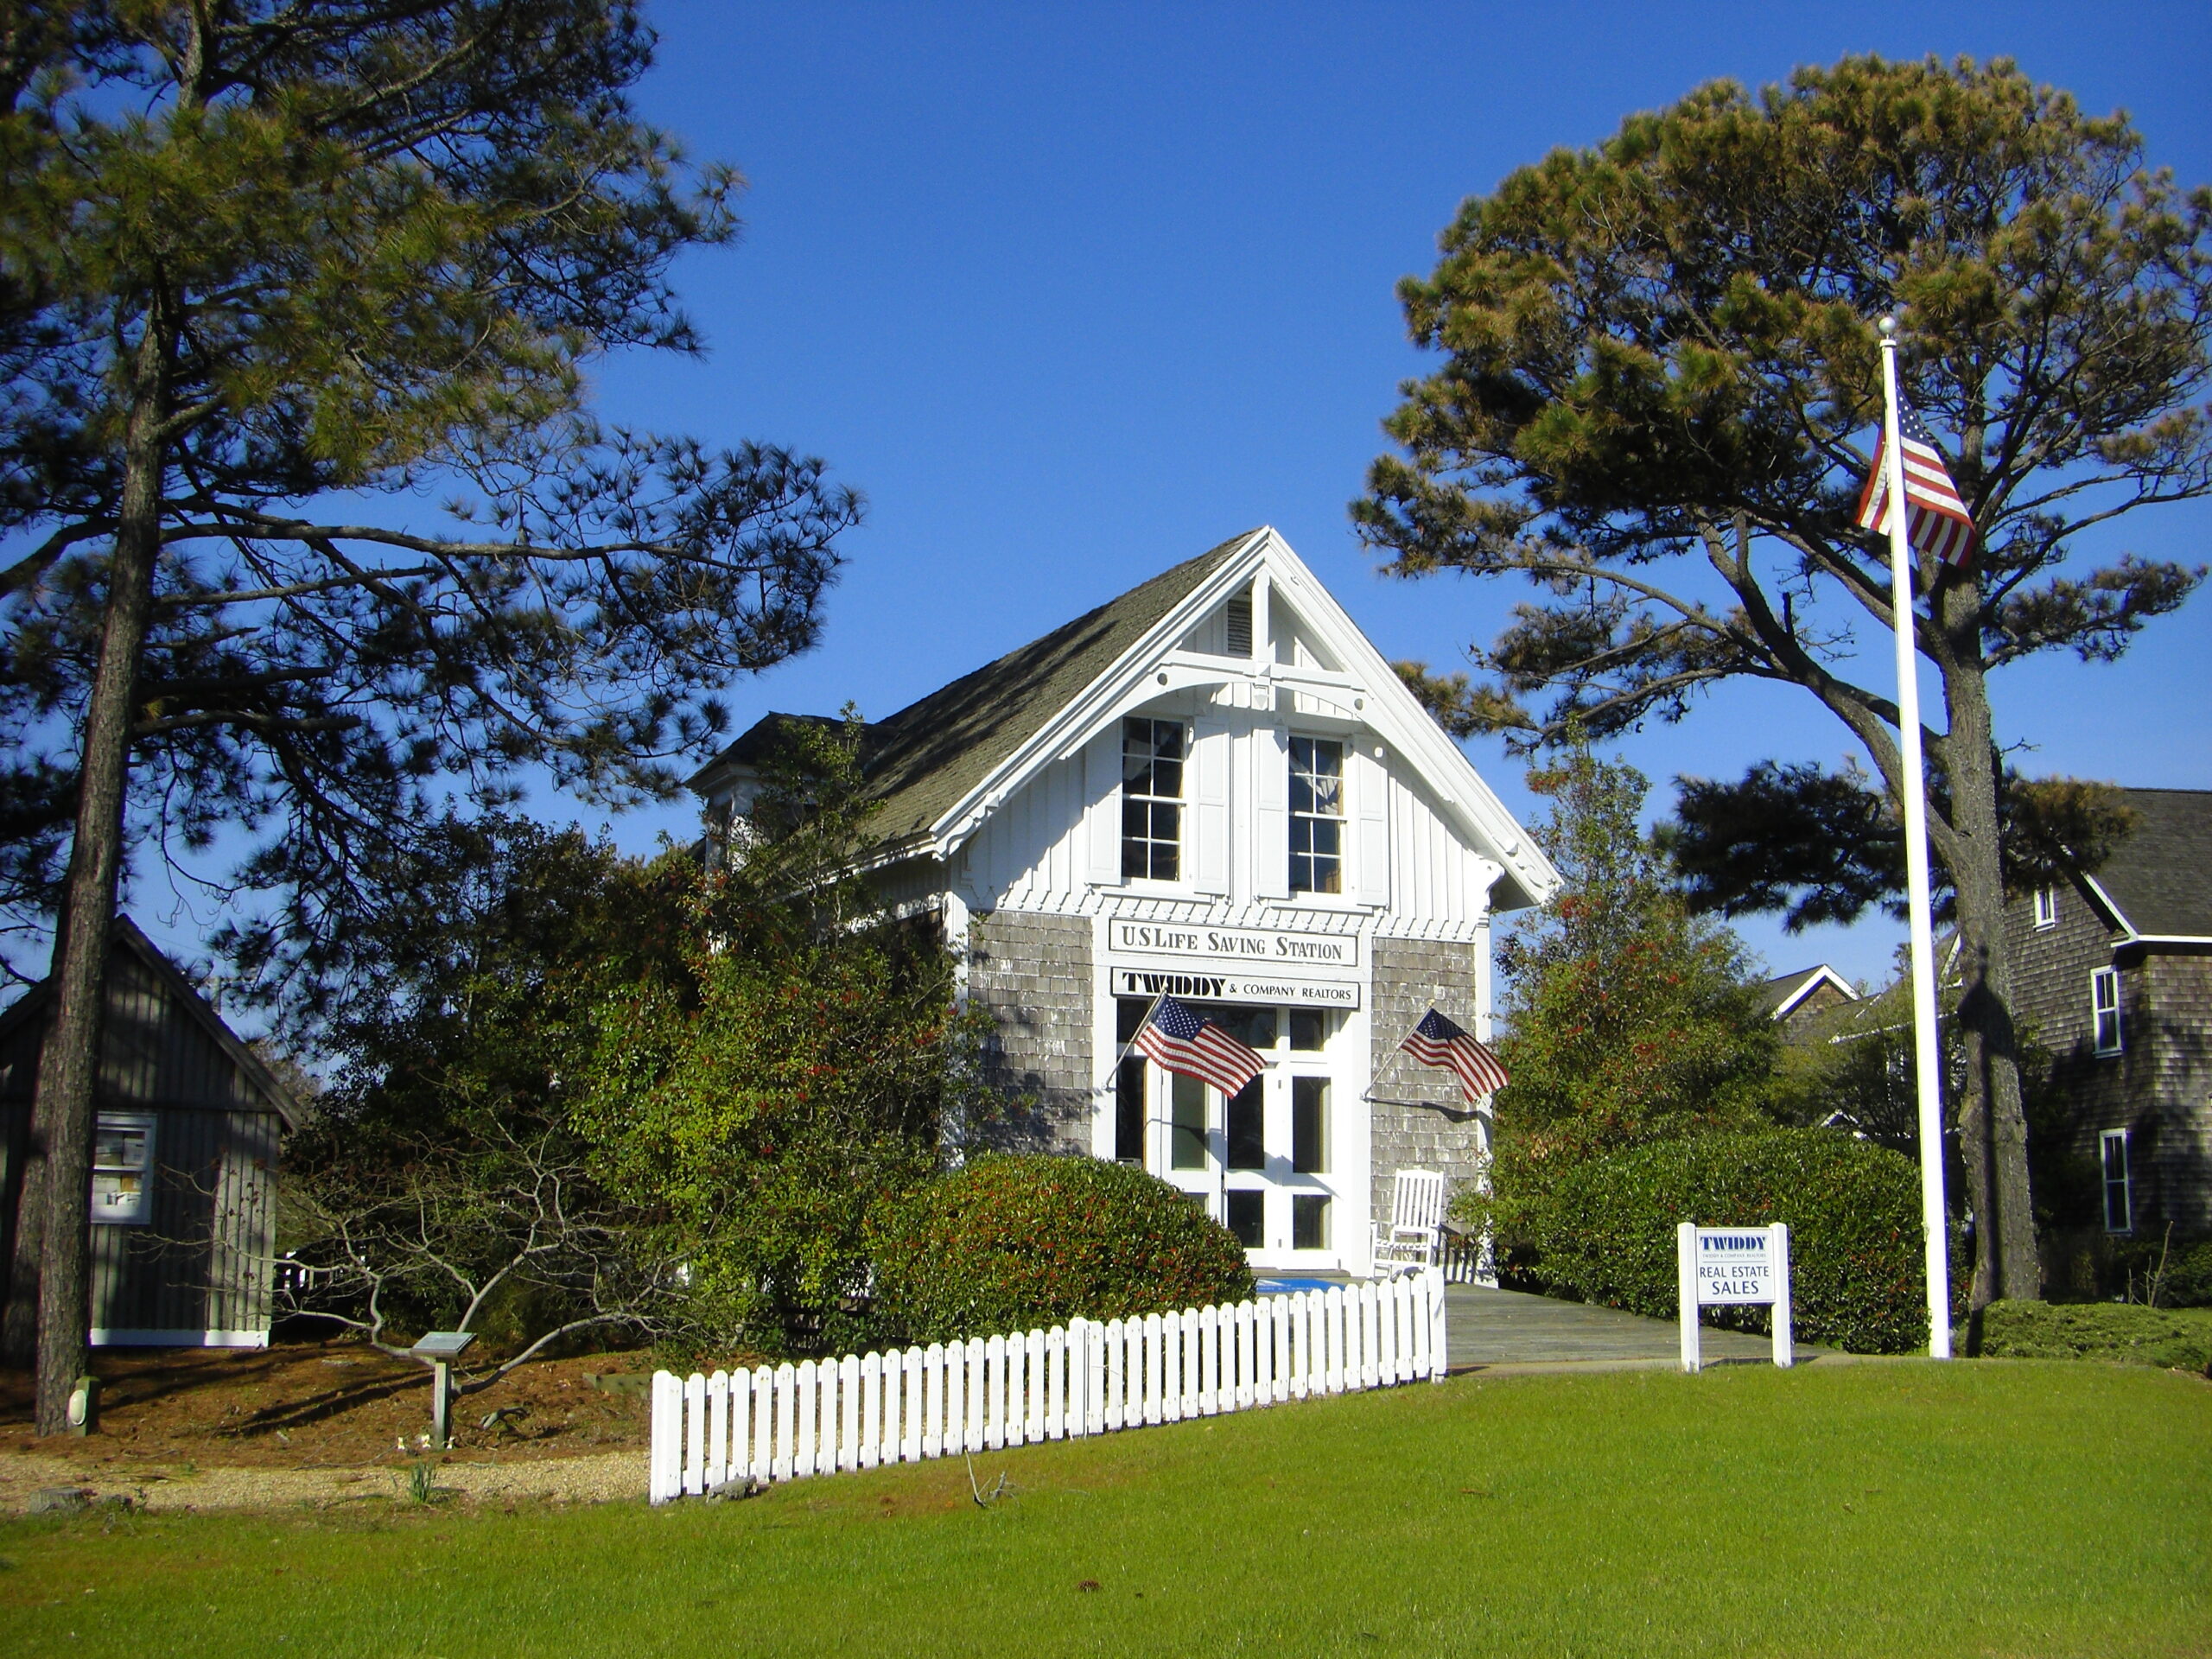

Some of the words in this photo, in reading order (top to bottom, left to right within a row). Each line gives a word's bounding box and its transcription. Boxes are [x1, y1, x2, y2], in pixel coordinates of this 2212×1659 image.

[1208, 932, 1266, 955] SAVING
[1276, 937, 1342, 959] STATION
[1122, 972, 1226, 997] TWIDDY
[1230, 983, 1237, 993] &
[1243, 983, 1296, 996] COMPANY
[1302, 988, 1351, 1000] REALTORS
[1700, 1236, 1766, 1250] TWIDDY
[1700, 1267, 1726, 1278] REAL
[1732, 1266, 1770, 1277] ESTATE
[1712, 1281, 1759, 1295] SALES
